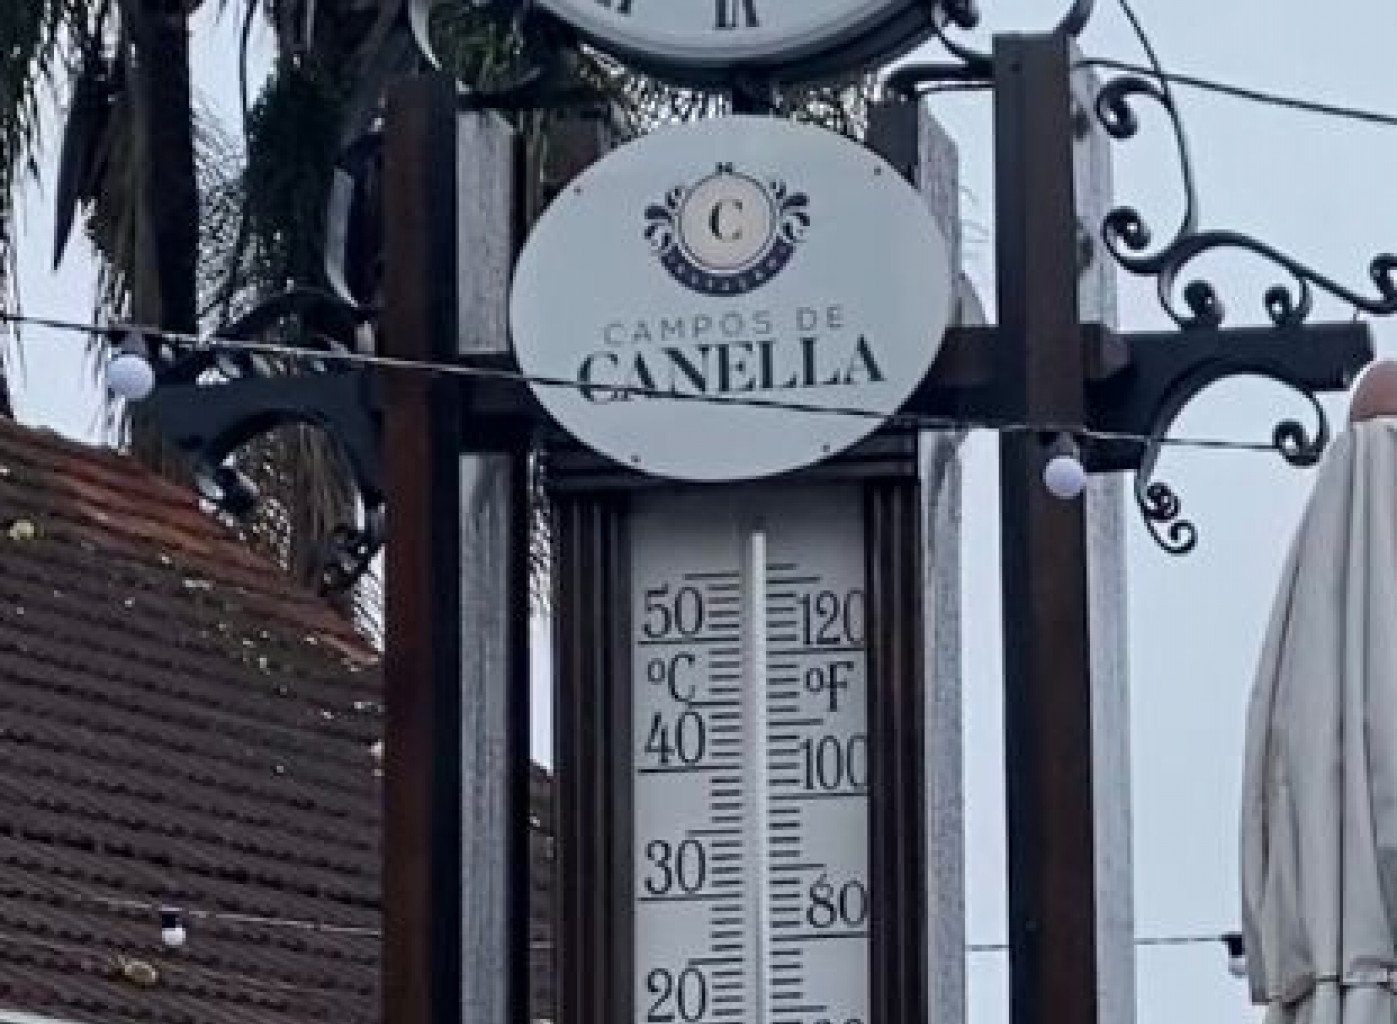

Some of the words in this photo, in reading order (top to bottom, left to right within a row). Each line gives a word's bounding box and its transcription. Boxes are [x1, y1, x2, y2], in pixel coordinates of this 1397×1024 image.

[708, 200, 744, 241] C
[603, 307, 773, 347] CAMPOS
[796, 303, 845, 330] DE
[577, 334, 886, 405] CANELLA
[643, 584, 704, 639] 50
[800, 589, 865, 646] 120
[644, 711, 706, 765] 40
[801, 734, 867, 791] 100
[645, 839, 706, 895] 30
[806, 875, 867, 930] 80
[645, 967, 708, 1024] 20
